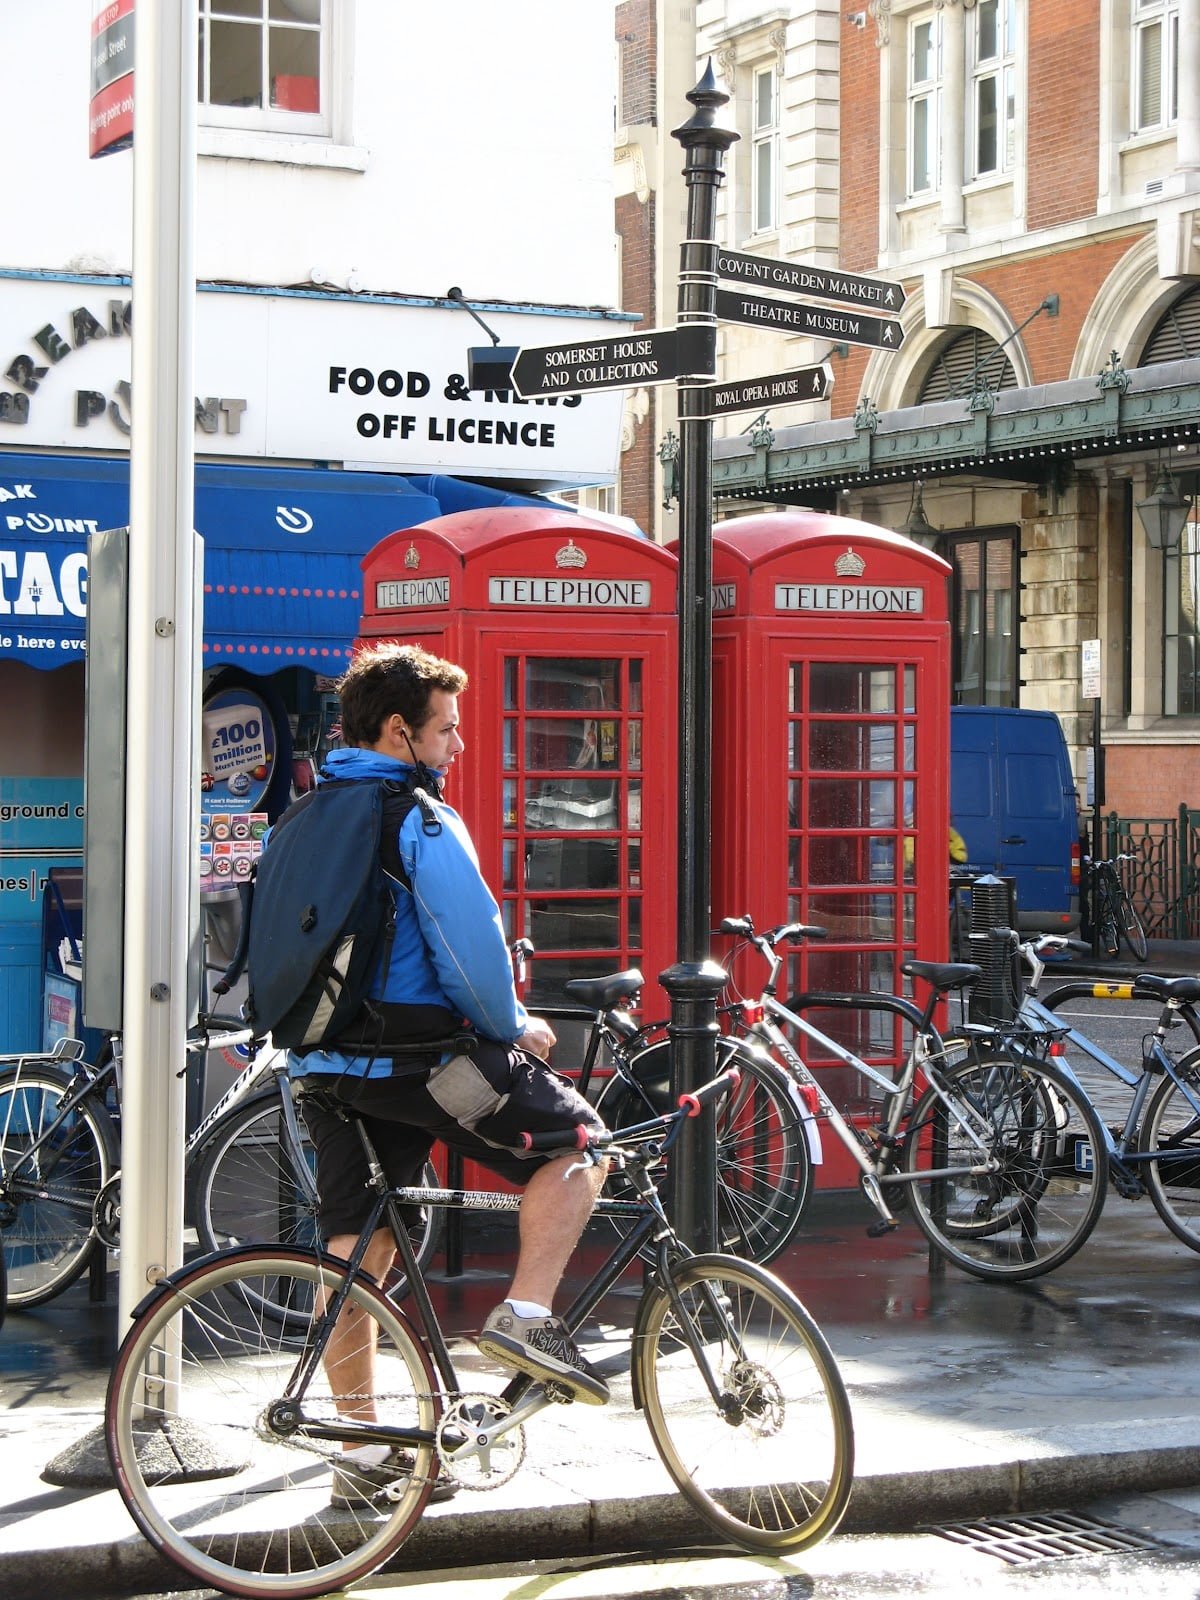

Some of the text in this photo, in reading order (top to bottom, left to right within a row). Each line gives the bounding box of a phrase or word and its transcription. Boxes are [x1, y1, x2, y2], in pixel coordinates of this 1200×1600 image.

[109, 35, 127, 58] Street
[718, 257, 883, 302] COVENT GARDEN MARKET
[741, 301, 860, 335] THEATRE MUSEUM
[545, 340, 653, 367] SOMERSET HOUSE
[329, 366, 431, 398] FOOD
[443, 373, 472, 402] &
[541, 360, 659, 388] AND COLLECTIONS
[715, 379, 799, 407] ROYAL OPERA HOUSE
[356, 412, 556, 448] OFF LICENCE
[6, 512, 99, 534] POINT
[28, 587, 43, 596] THE
[380, 579, 449, 606] TELEPHONE
[494, 579, 644, 606] TELEPHONE
[780, 587, 918, 612] TELEPHONE
[17, 635, 56, 649] here
[212, 719, 260, 749] £100
[214, 743, 262, 763] million
[215, 754, 262, 771] Must be won
[0, 802, 69, 821] ground
